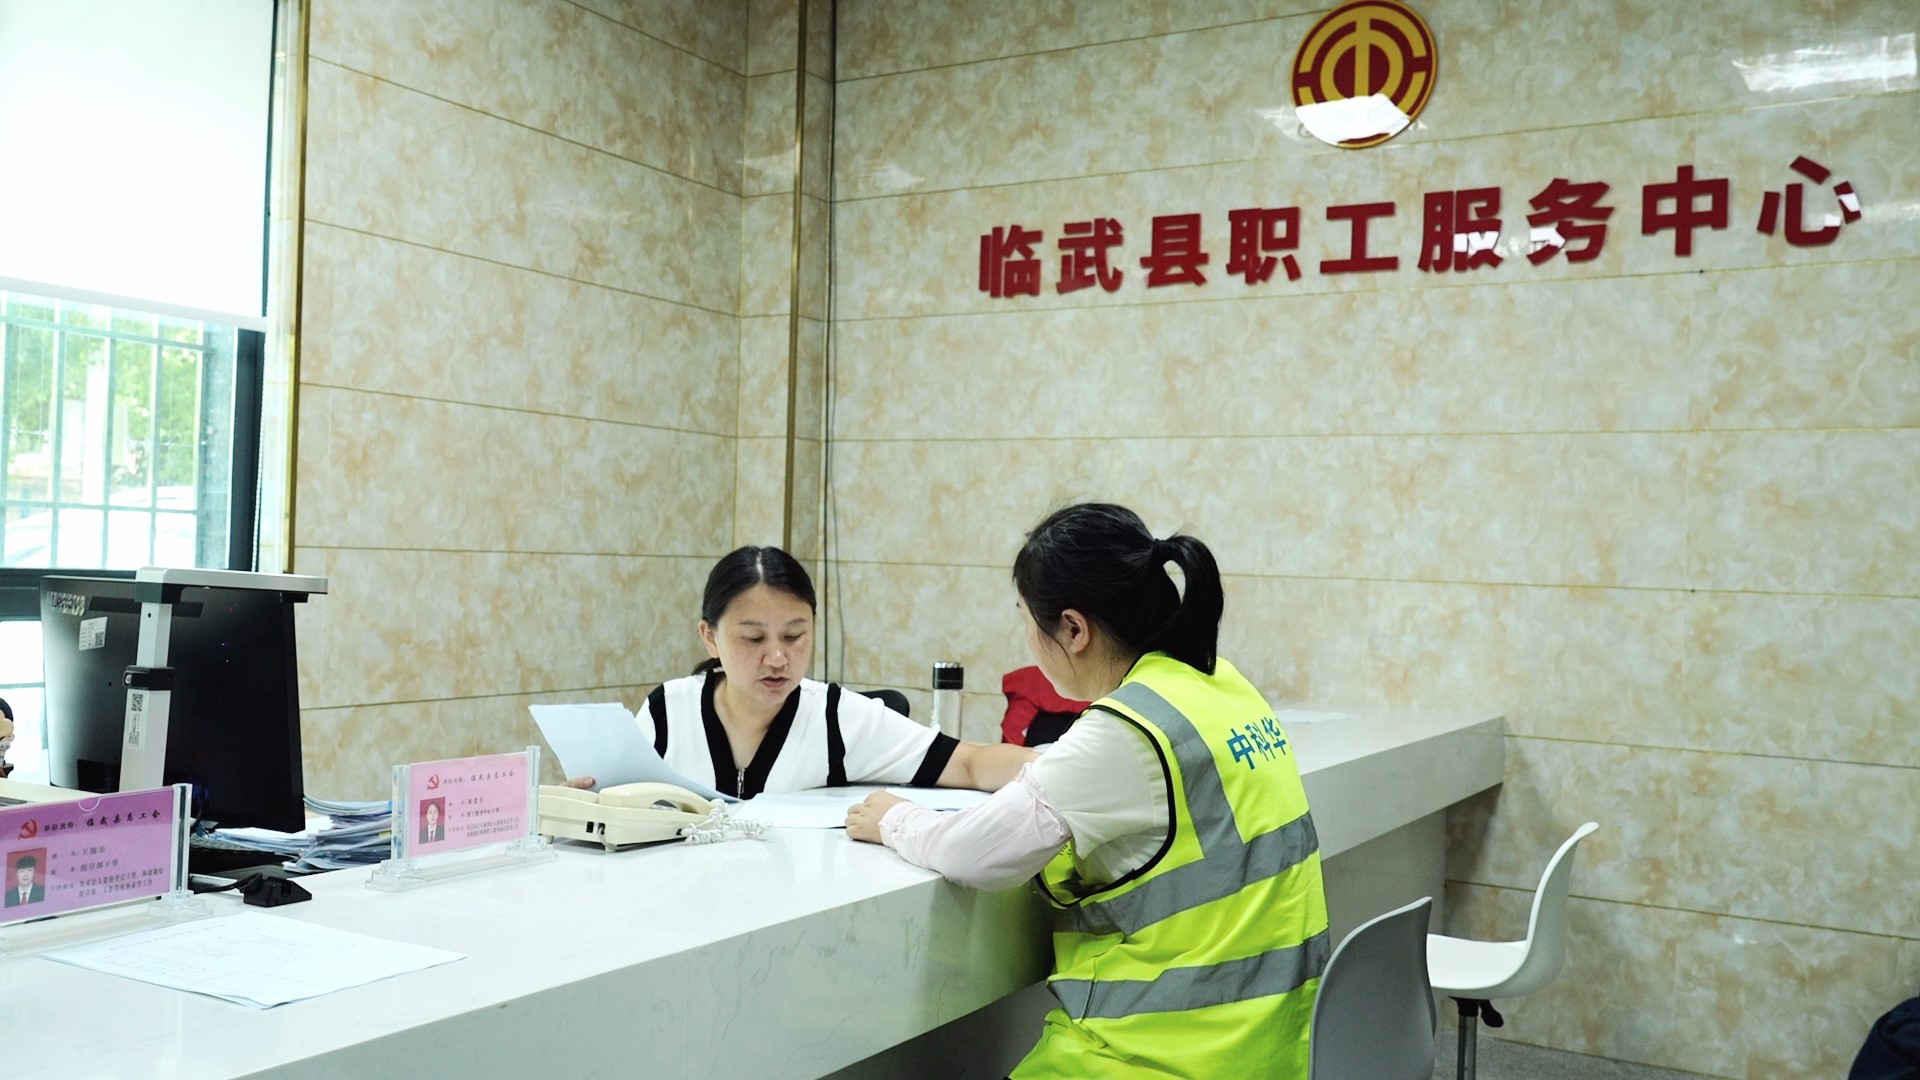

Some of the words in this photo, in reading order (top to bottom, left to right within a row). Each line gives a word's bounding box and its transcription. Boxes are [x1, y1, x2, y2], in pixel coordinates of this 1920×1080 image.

[978, 154, 1863, 299] 临武县职工服务中心
[86, 809, 161, 828] 临武县总工会
